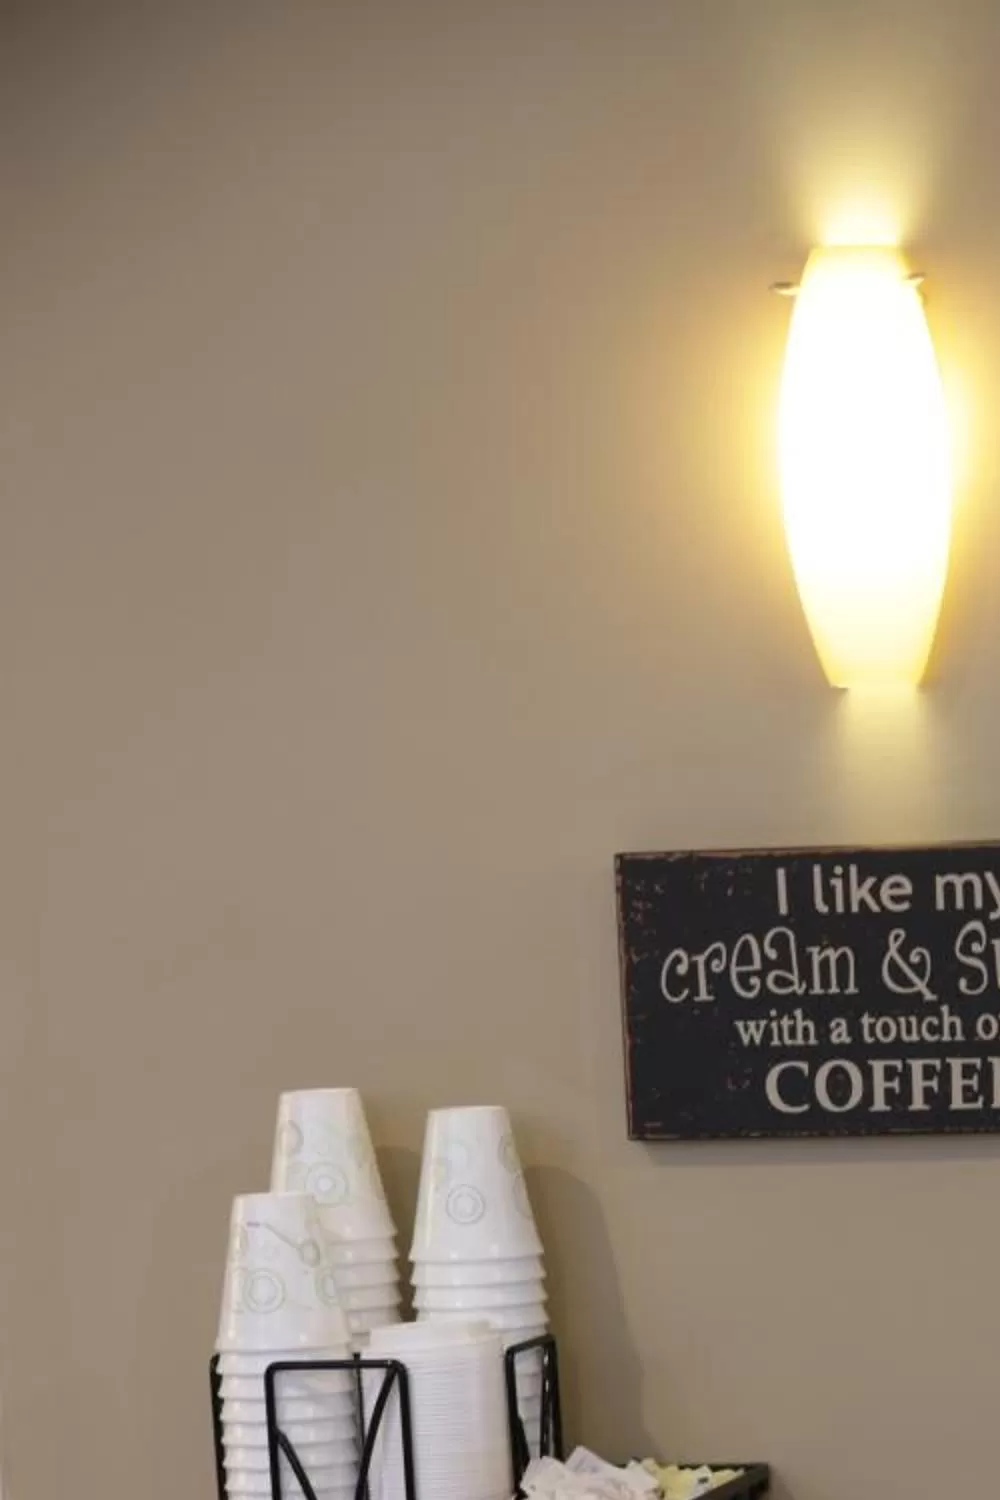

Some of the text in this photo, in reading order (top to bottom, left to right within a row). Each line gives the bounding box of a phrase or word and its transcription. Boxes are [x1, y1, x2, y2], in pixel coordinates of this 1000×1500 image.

[777, 867, 788, 915] I
[813, 863, 913, 914] like
[661, 926, 859, 1003] cream
[882, 928, 938, 1001] &
[735, 1008, 817, 1046] with
[829, 1018, 852, 1044] a
[861, 1004, 964, 1044] touch
